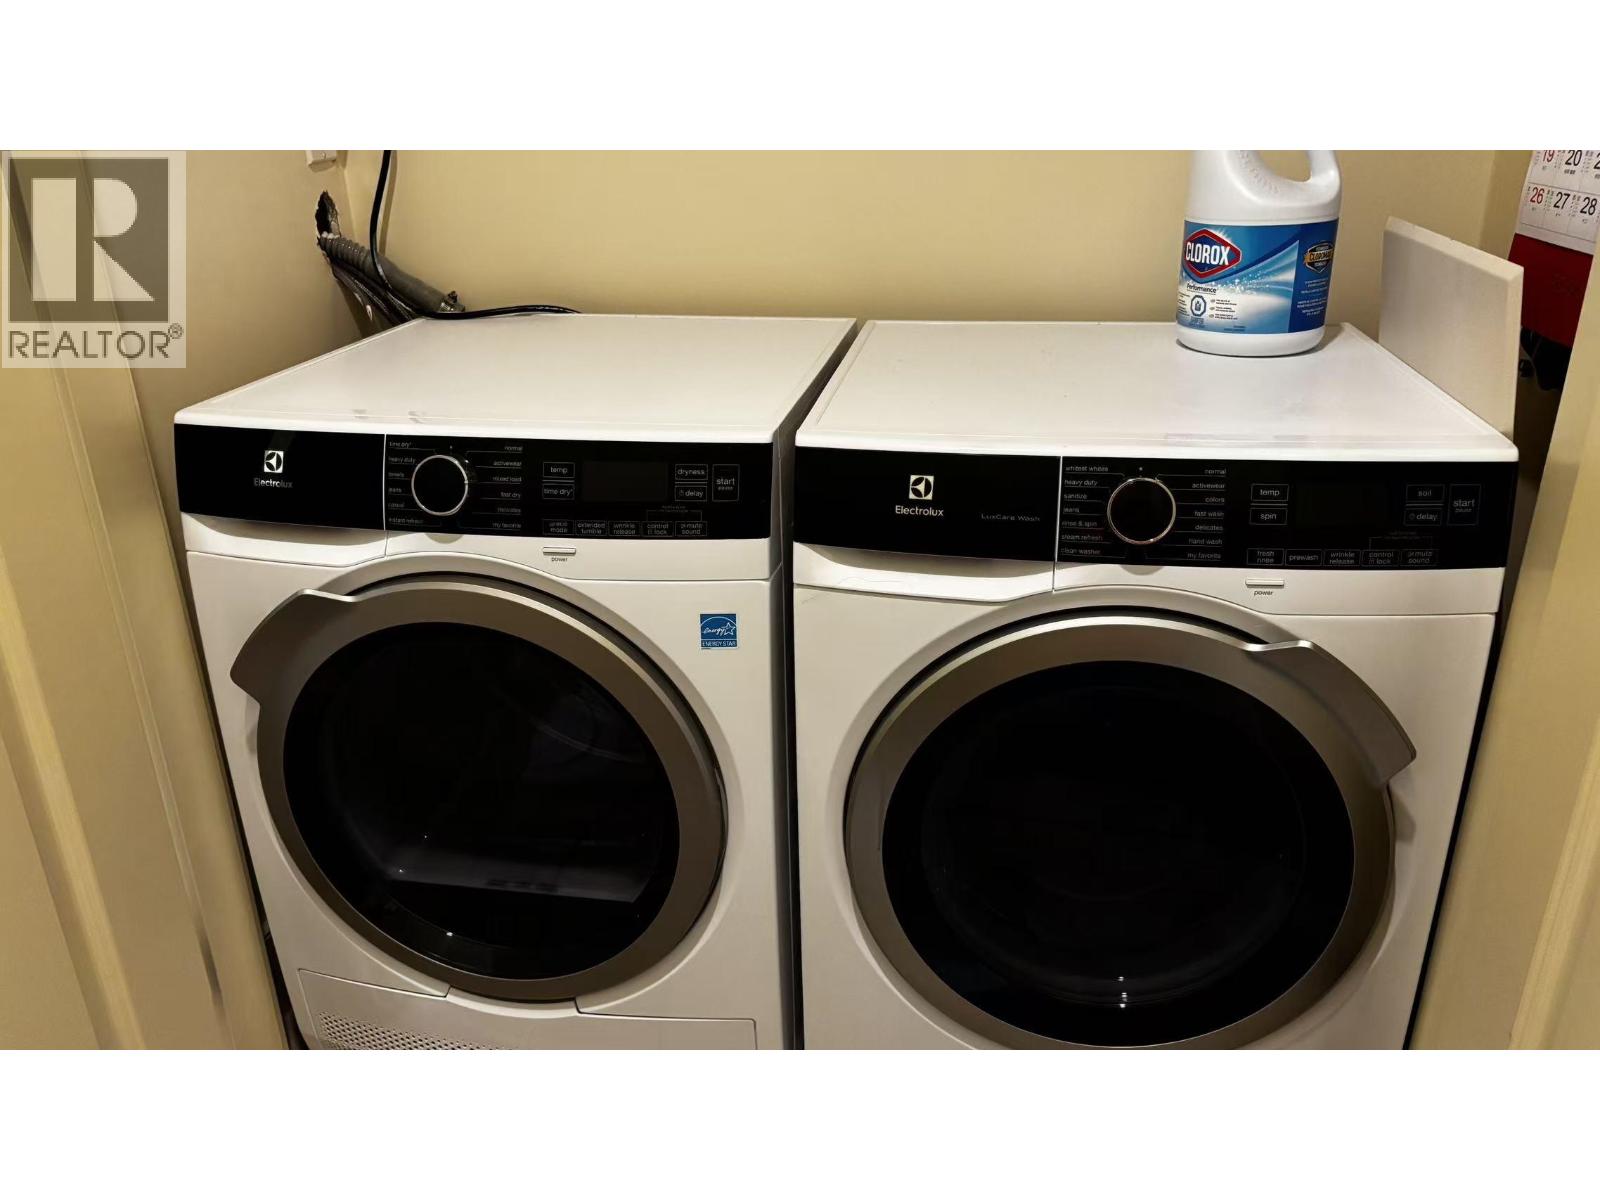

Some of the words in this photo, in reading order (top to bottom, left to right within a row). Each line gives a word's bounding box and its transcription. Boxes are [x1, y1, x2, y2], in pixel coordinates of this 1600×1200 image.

[1543, 150, 1555, 163] 19
[1565, 150, 1583, 167] 20
[1530, 187, 1545, 205] 26
[1553, 192, 1571, 210] 27
[1580, 196, 1598, 216] 28
[1185, 242, 1231, 266] CLOROX
[550, 466, 568, 475] temp
[677, 468, 705, 476] dryness
[253, 478, 293, 488] Electrolux
[716, 478, 735, 486] start
[685, 490, 704, 498] delay
[1259, 489, 1280, 497] temp
[1417, 489, 1433, 497] soil
[1453, 499, 1476, 507] start
[895, 505, 945, 517] Electrolux
[1260, 512, 1278, 521] spin
[1416, 513, 1438, 521] delay
